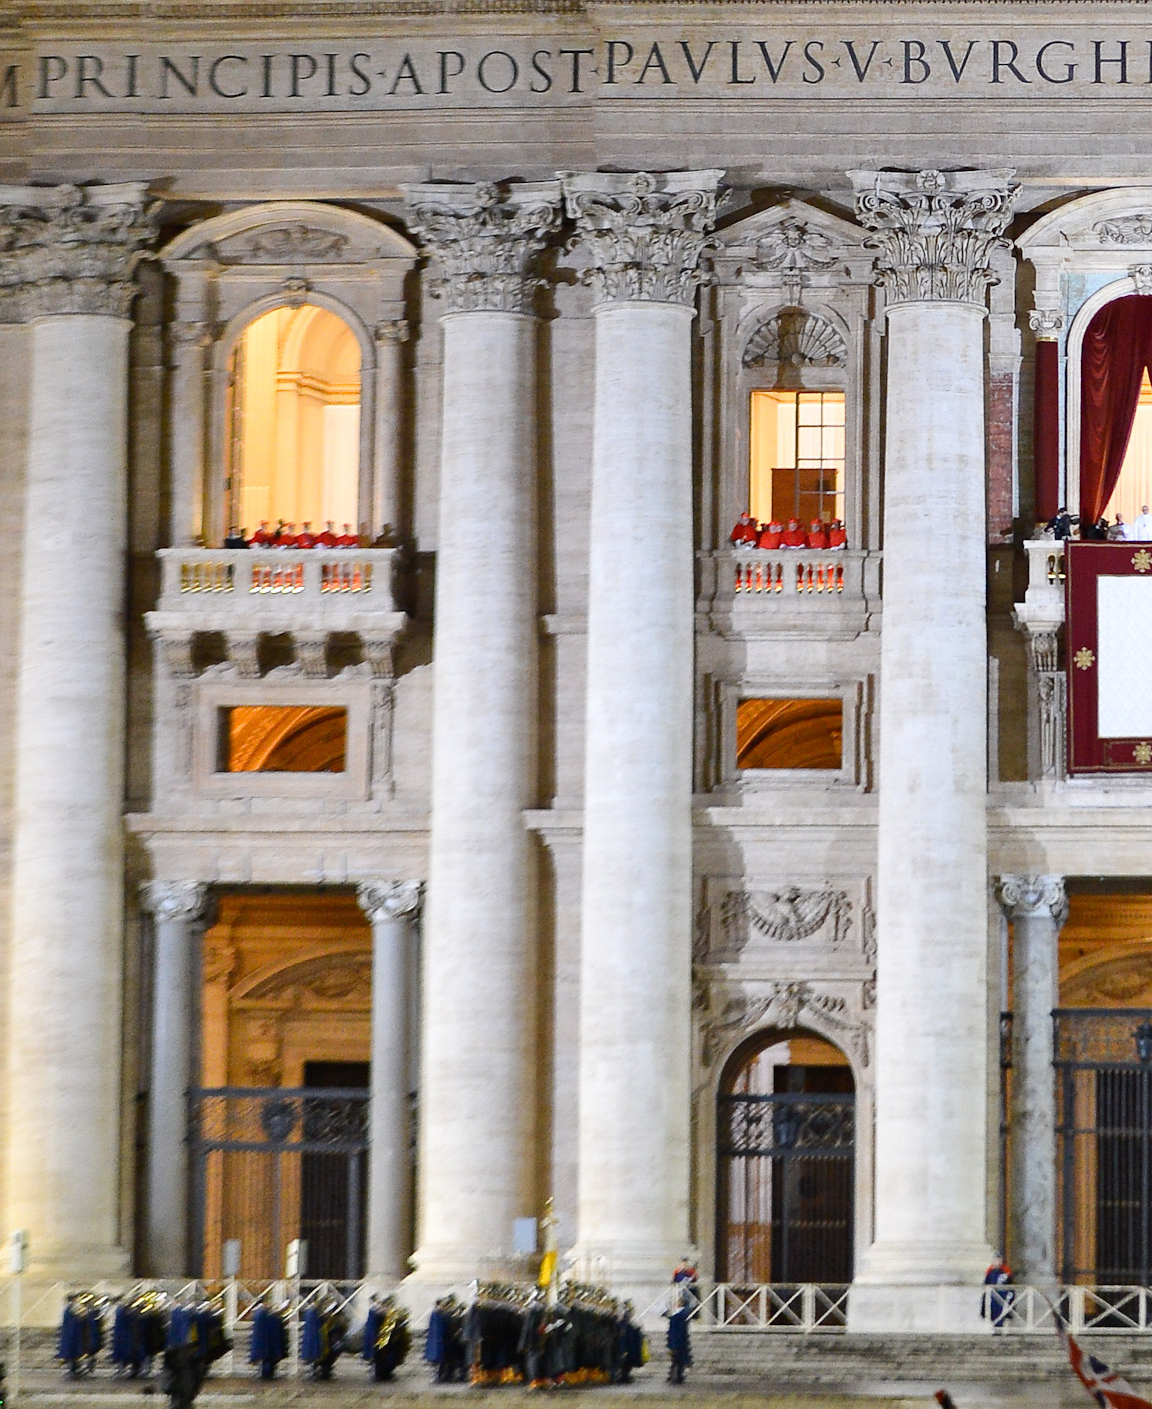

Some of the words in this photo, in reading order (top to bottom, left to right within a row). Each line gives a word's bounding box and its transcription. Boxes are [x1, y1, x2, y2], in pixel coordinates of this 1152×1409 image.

[37, 52, 372, 99] PRINCIPIS
[386, 47, 595, 95] APOST
[603, 40, 826, 85] PAVLVS
[840, 39, 884, 84] V
